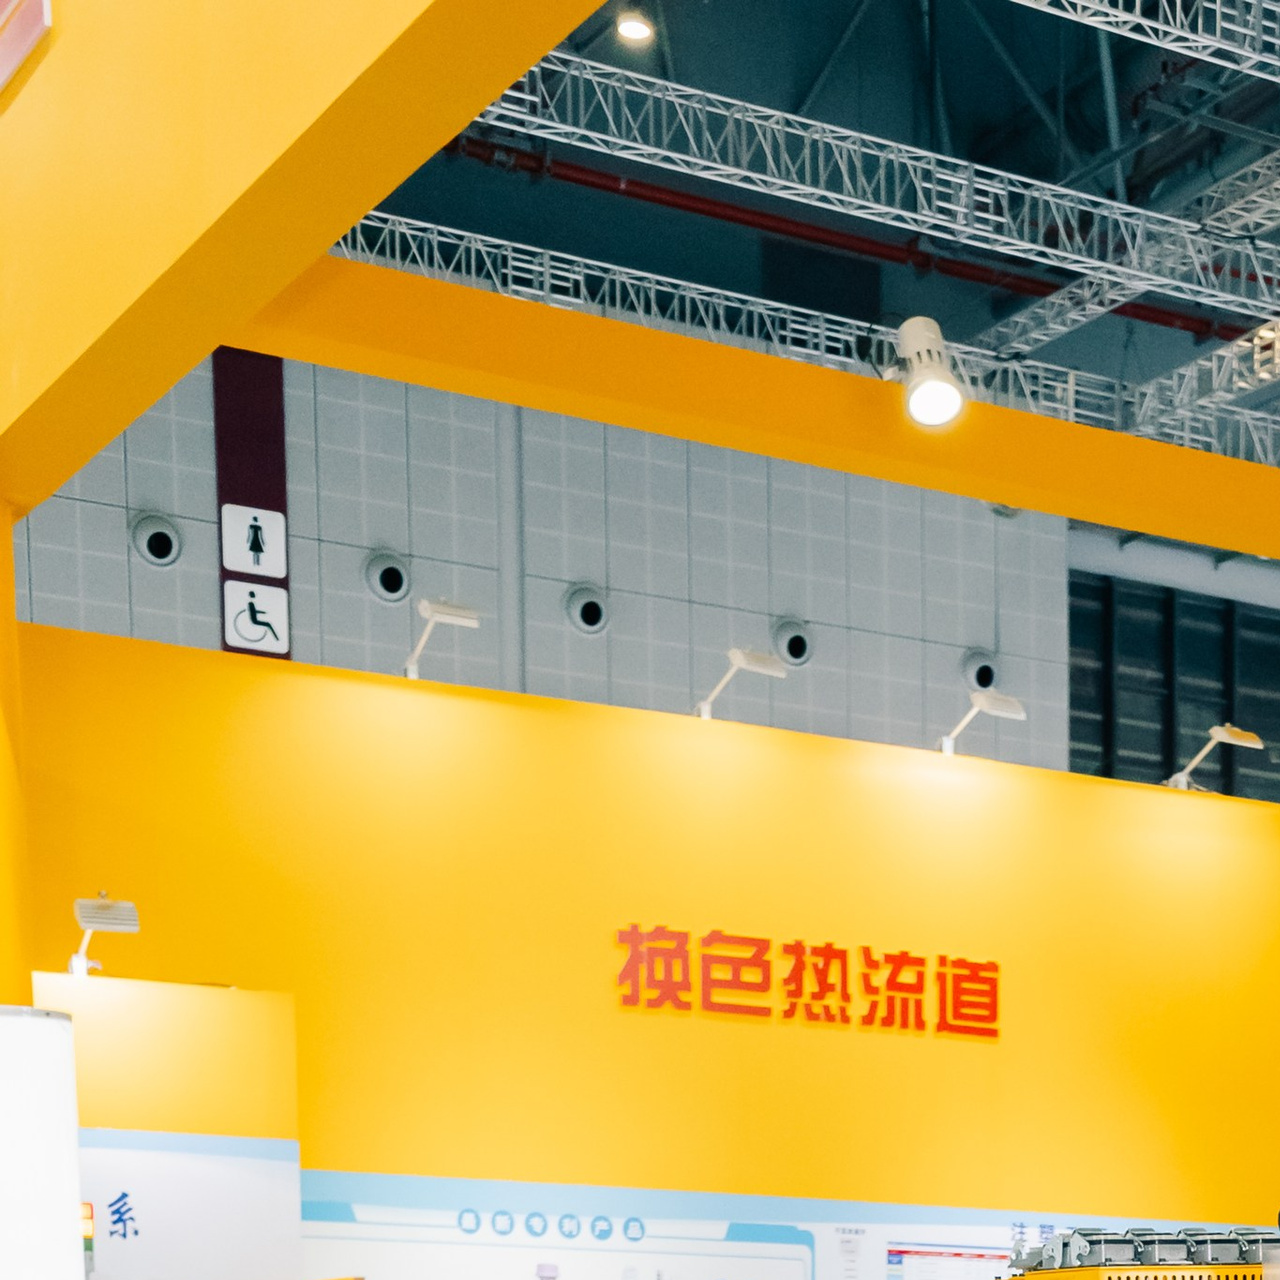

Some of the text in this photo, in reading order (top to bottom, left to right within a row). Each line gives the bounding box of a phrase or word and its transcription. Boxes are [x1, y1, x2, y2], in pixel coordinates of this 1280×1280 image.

[616, 923, 999, 1038] 换色热流道
[106, 1190, 140, 1240] 系
